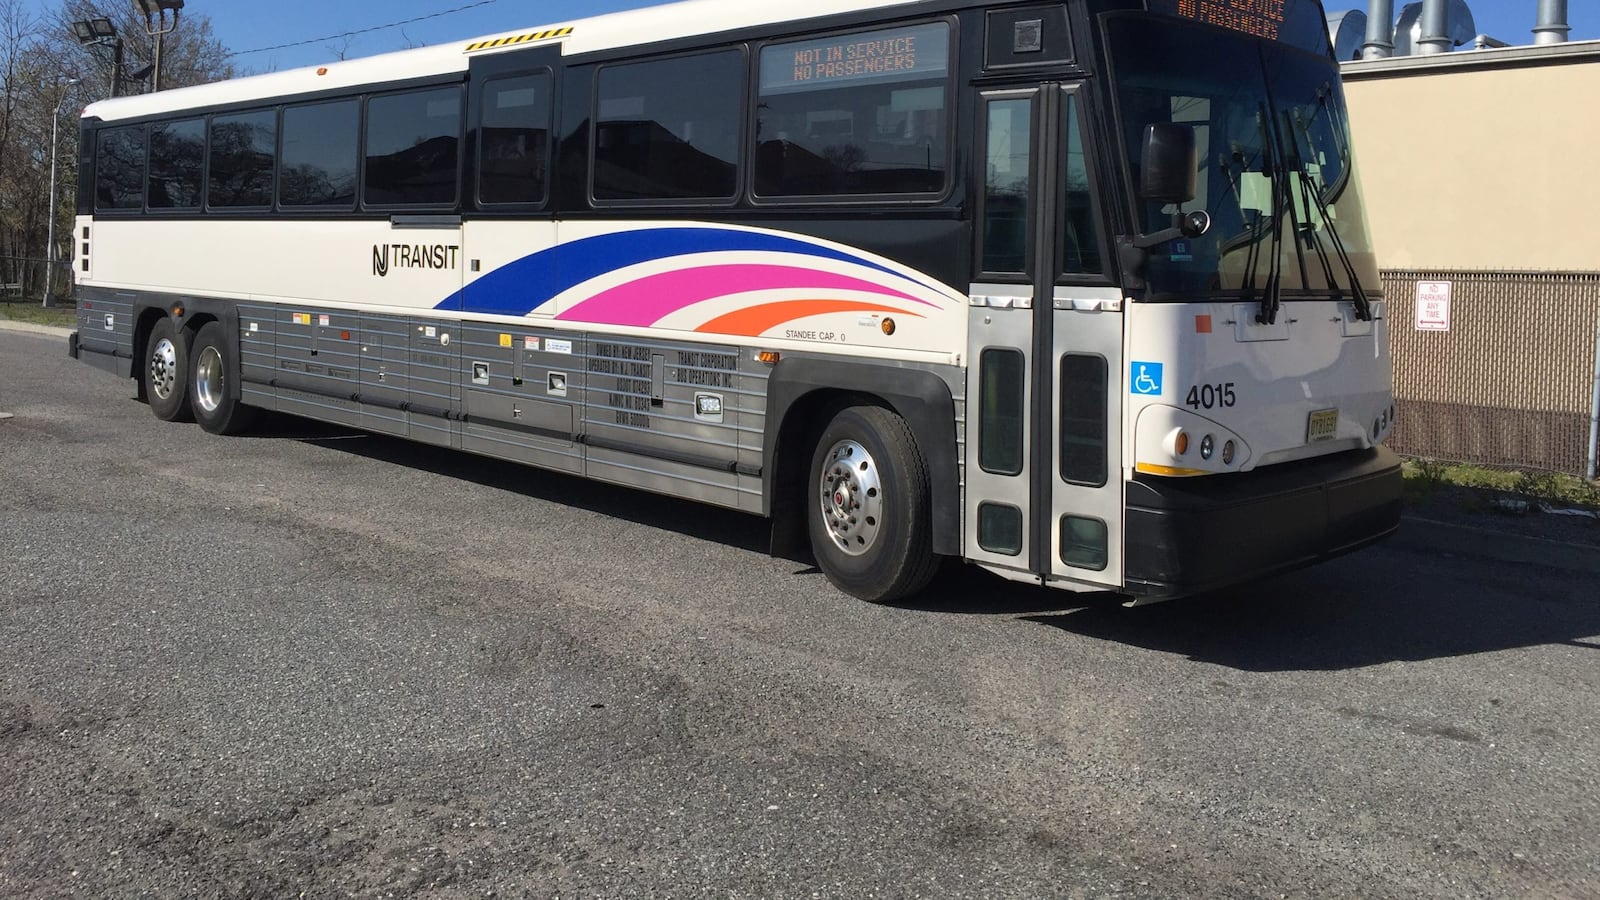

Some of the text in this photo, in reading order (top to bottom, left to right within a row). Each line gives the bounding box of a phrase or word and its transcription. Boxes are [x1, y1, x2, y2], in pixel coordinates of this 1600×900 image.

[1178, 0, 1278, 40] NO PASSENGERS
[794, 36, 916, 66] NOT IN SERVICE
[793, 53, 916, 81] NO PASSENGERS
[391, 244, 459, 270] TRANSIT
[1420, 293, 1446, 301] PARKING
[1429, 284, 1439, 293] NO
[1425, 310, 1440, 318] TIME
[785, 329, 816, 340] STANDEE
[1186, 382, 1236, 410] 4015
